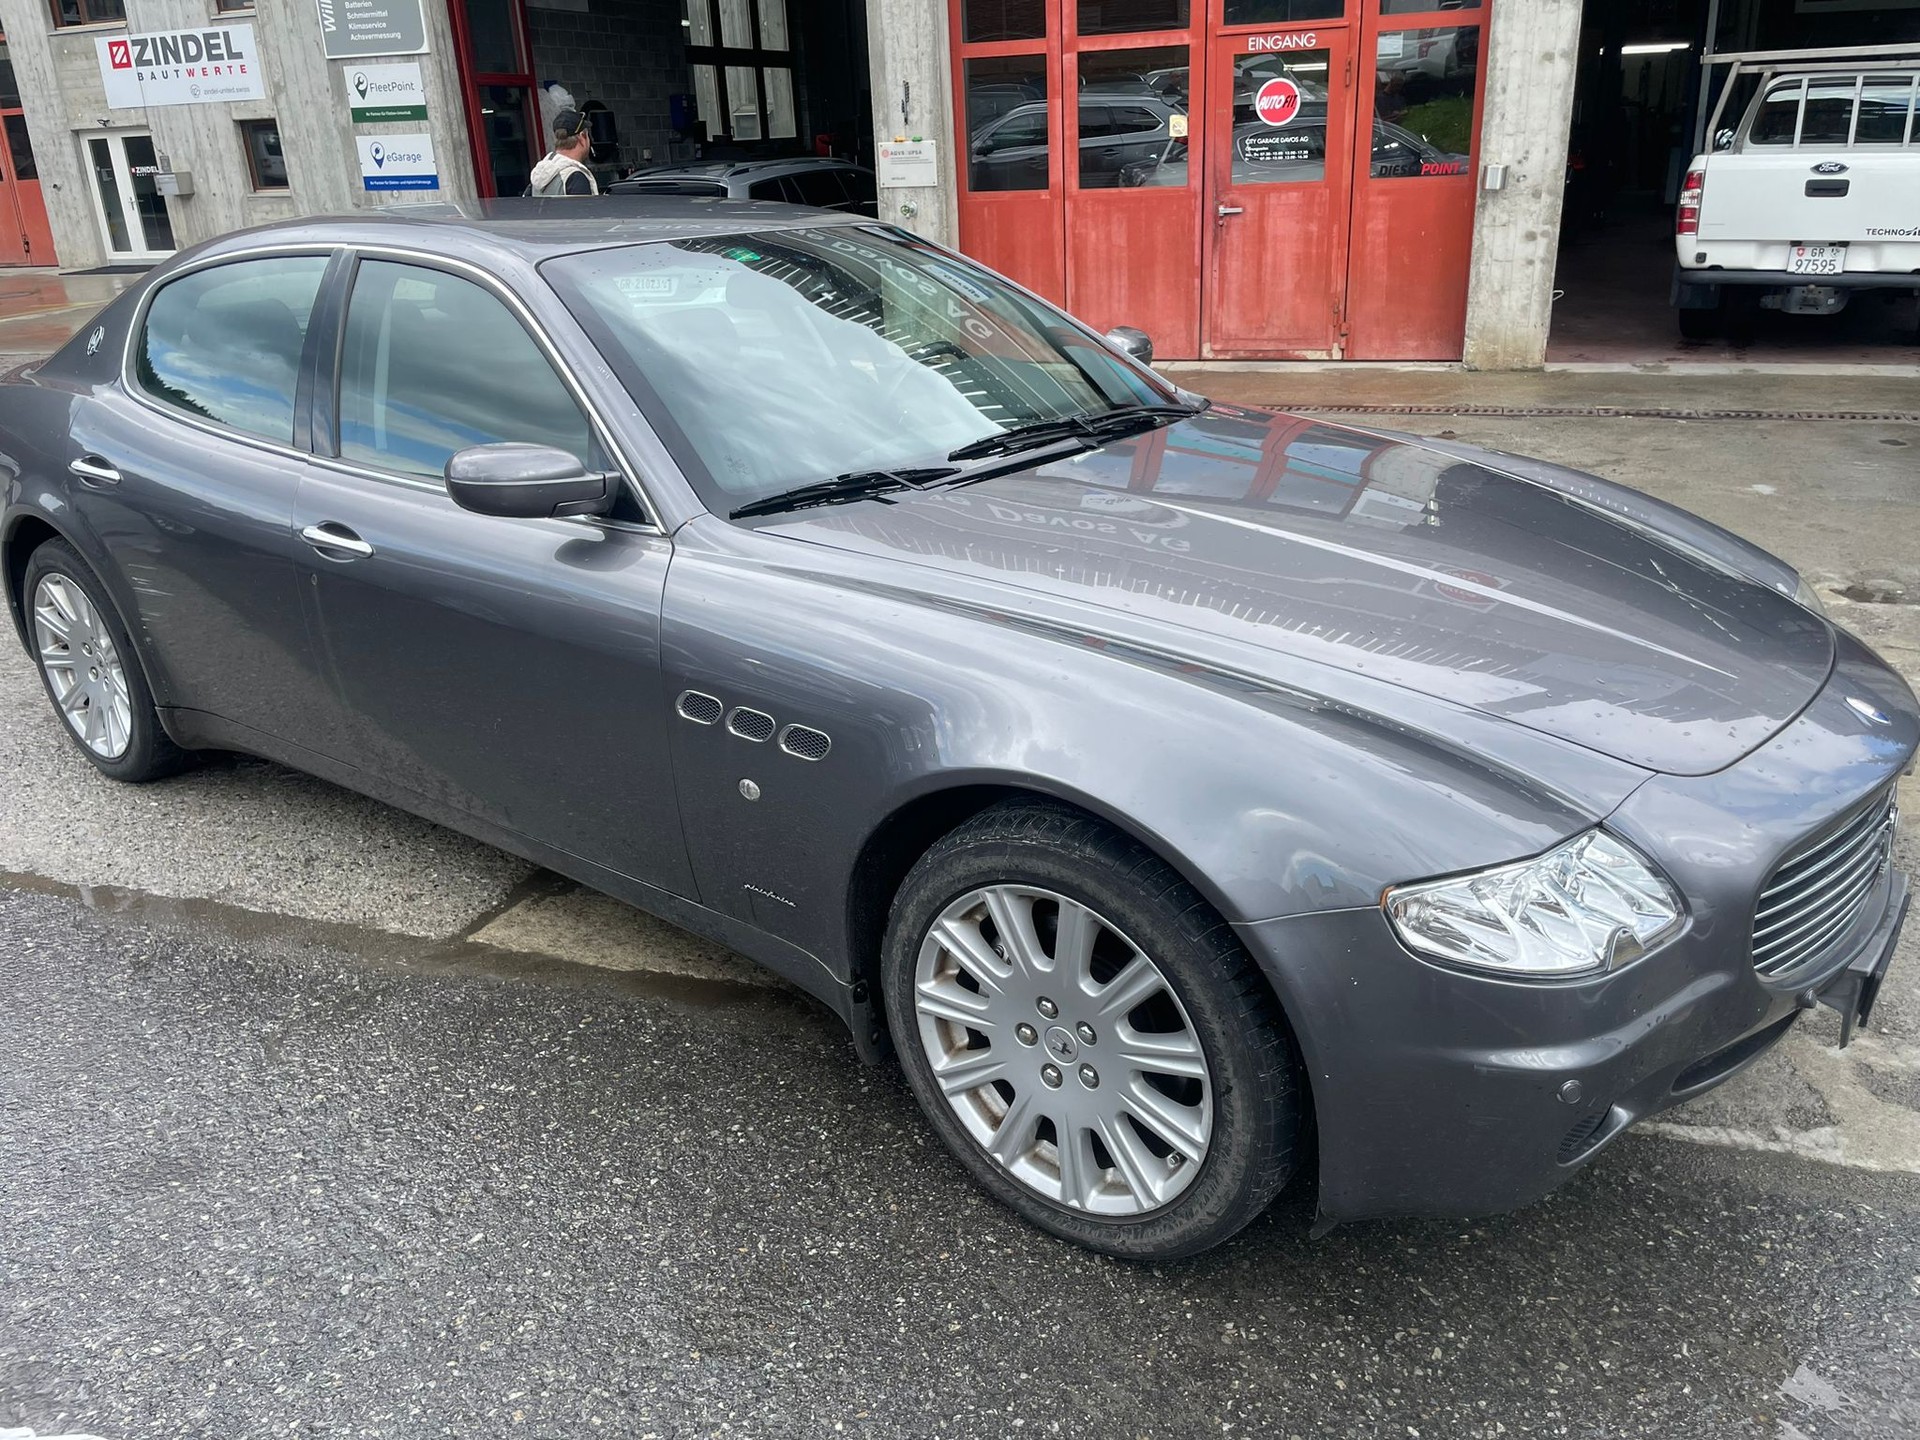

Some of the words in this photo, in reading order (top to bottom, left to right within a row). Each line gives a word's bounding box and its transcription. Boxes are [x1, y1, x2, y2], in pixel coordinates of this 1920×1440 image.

[344, 1, 373, 9] Batterien
[346, 10, 388, 20] Schmiermittel
[348, 21, 387, 30] Klimaservice
[350, 32, 402, 41] Achsvermessung
[1248, 33, 1317, 51] EINGANG
[131, 31, 244, 67] ZINDEL
[369, 81, 415, 93] FleetPoint
[1257, 136, 1280, 144] GARAGE
[1280, 135, 1299, 143] DAVOS
[386, 152, 422, 163] eGarage
[1379, 164, 1419, 176] DIES
[1421, 162, 1460, 175] POINT
[1811, 248, 1825, 257] GR
[1795, 259, 1837, 272] 97595
